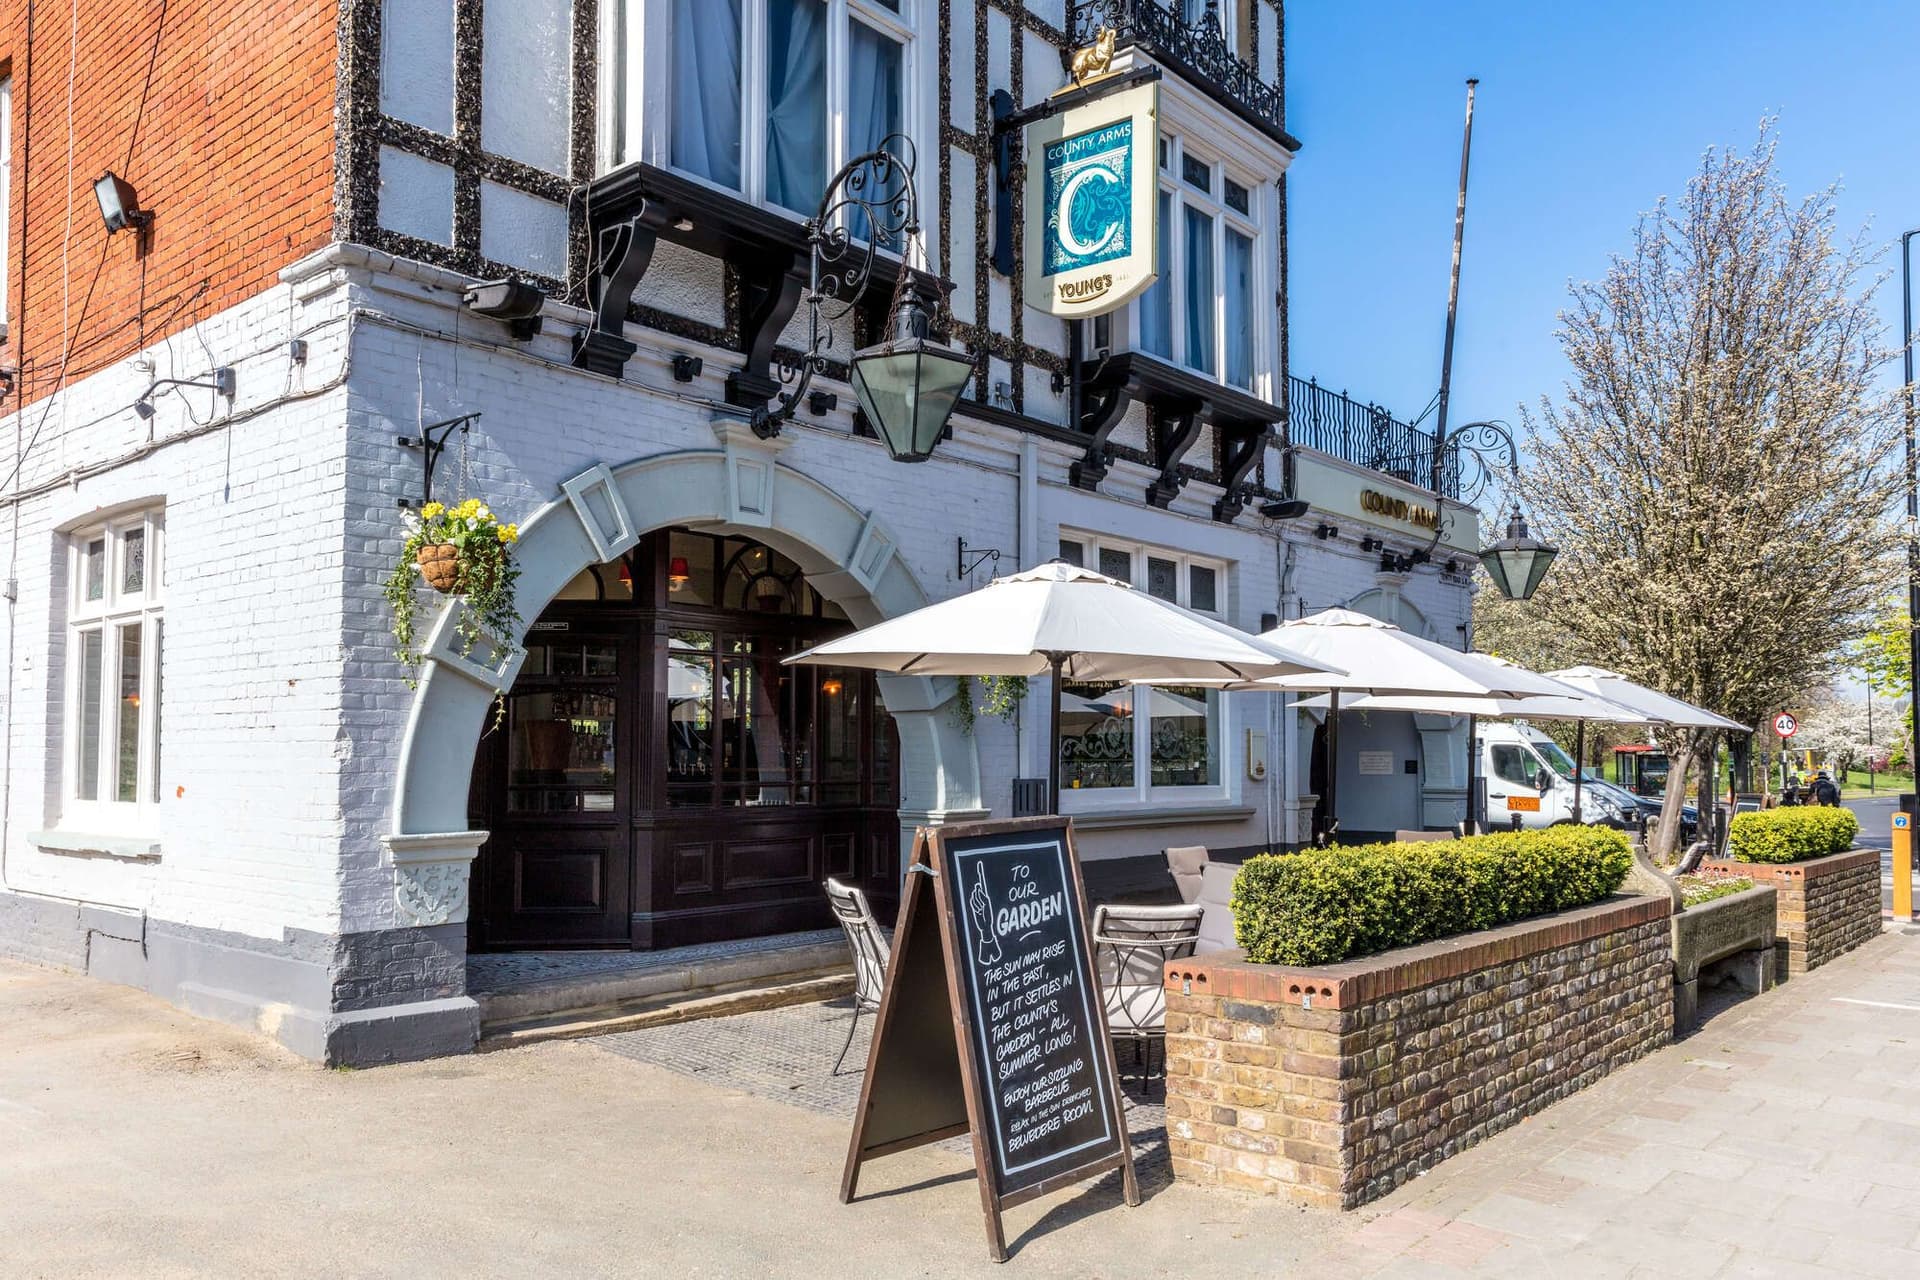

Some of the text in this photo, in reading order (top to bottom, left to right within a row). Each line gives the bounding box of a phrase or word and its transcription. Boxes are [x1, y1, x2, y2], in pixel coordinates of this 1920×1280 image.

[1048, 124, 1132, 160] COUNTY ARMS
[1058, 274, 1113, 298] YOUNG'S
[1360, 489, 1411, 522] COUNTY
[1777, 719, 1794, 730] 40
[1008, 882, 1040, 902] OUR
[1010, 865, 1030, 882] TO
[997, 891, 1062, 937] GARDEN
[984, 939, 1066, 987] THE SUN MAY RISE
[987, 964, 1049, 1003] IN THE EAST,
[990, 970, 1073, 1022] BUT IT SETTLES IN
[991, 999, 1058, 1044] THE COUNTY'S
[996, 1027, 1036, 1062] GARDEN
[1051, 1013, 1070, 1033] ALL
[998, 1024, 1077, 1080] SUMMER LONG!
[1003, 1057, 1083, 1108] ENJOY OUR SIZZLING
[1025, 1080, 1070, 1113] BARBECUE
[1008, 1100, 1094, 1153] BELVEDERE ROOM
[1030, 1114, 1038, 1125] IN
[1038, 1108, 1049, 1120] THE
